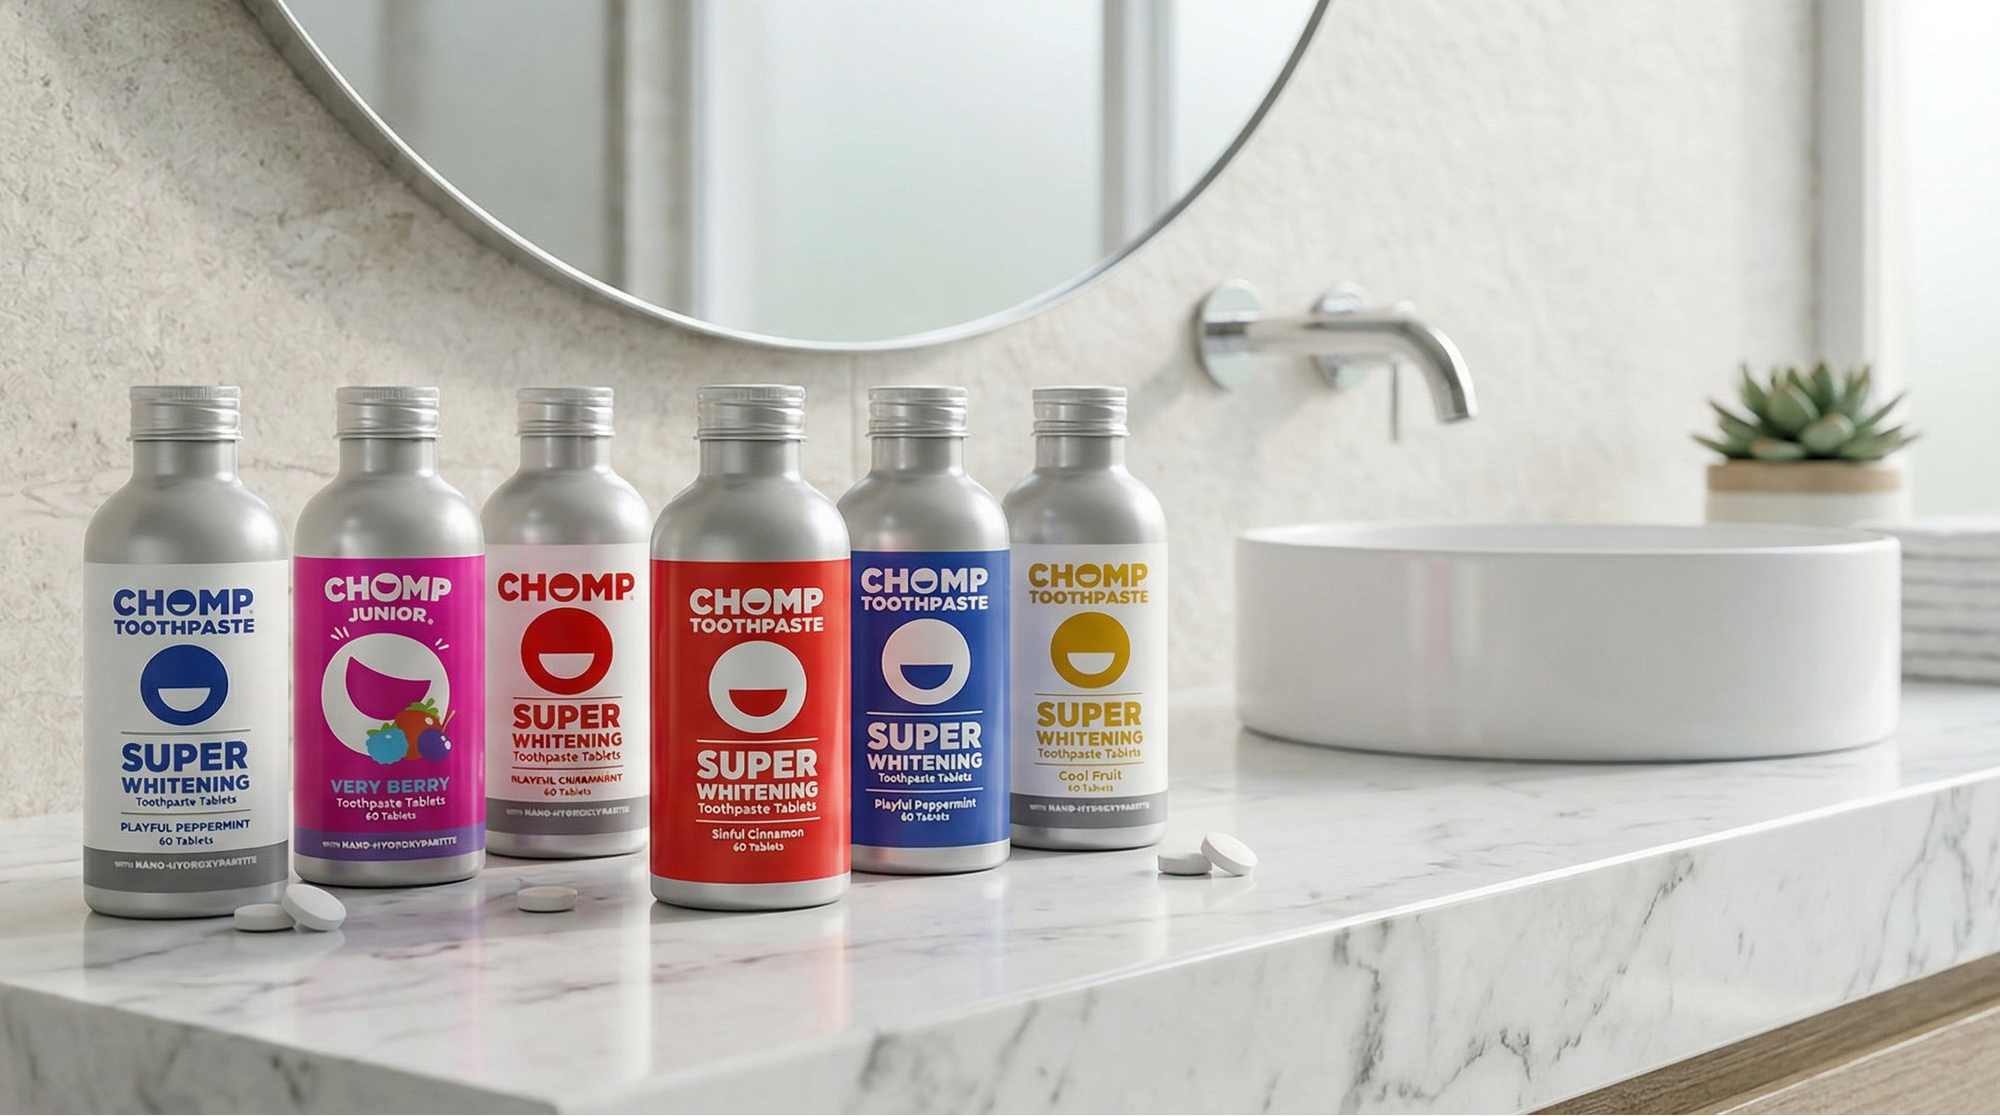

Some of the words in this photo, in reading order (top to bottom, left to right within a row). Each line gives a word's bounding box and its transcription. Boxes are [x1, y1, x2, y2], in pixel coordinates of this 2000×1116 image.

[861, 567, 989, 595] CHOMP
[1028, 562, 1149, 588] CHOMP
[324, 572, 452, 603] CHOMP
[497, 572, 635, 603] CHOMP
[113, 588, 254, 616] CHOMP
[689, 587, 824, 615] CHOMP
[861, 595, 989, 612] TOOTHPASTE
[1028, 590, 1149, 605] TOOTHPASTE
[348, 606, 427, 622] JUNIOR
[114, 618, 255, 636] TOOTHPASTE
[689, 616, 824, 634] TOOTHPASTE
[512, 703, 621, 731] SUPER
[1036, 701, 1142, 728] SUPER
[511, 732, 623, 749] WHITENING
[867, 721, 982, 751] SUPER
[1035, 730, 1143, 747] WHITENING
[121, 741, 248, 773] SUPER
[512, 751, 579, 765] Toothpaste
[696, 748, 818, 780] SUPER
[866, 752, 983, 771] WHITENING
[121, 774, 250, 794] WHITENING
[1058, 770, 1089, 781] Cool
[1092, 769, 1122, 781] Fruit
[330, 779, 382, 794] VERY
[387, 776, 450, 794] BERRY
[543, 788, 557, 797] 60
[696, 781, 819, 801] WHITENING
[697, 802, 771, 817] Toothpaste
[773, 800, 817, 814] Tablets
[874, 798, 912, 812] Playful
[365, 811, 379, 821] 60
[901, 812, 914, 822] 60
[121, 822, 173, 833] PLAYFUL
[176, 819, 251, 832] PEPPERMINT
[712, 828, 745, 840] Sinful
[747, 827, 805, 840] Cinnamon
[159, 837, 173, 846] 60
